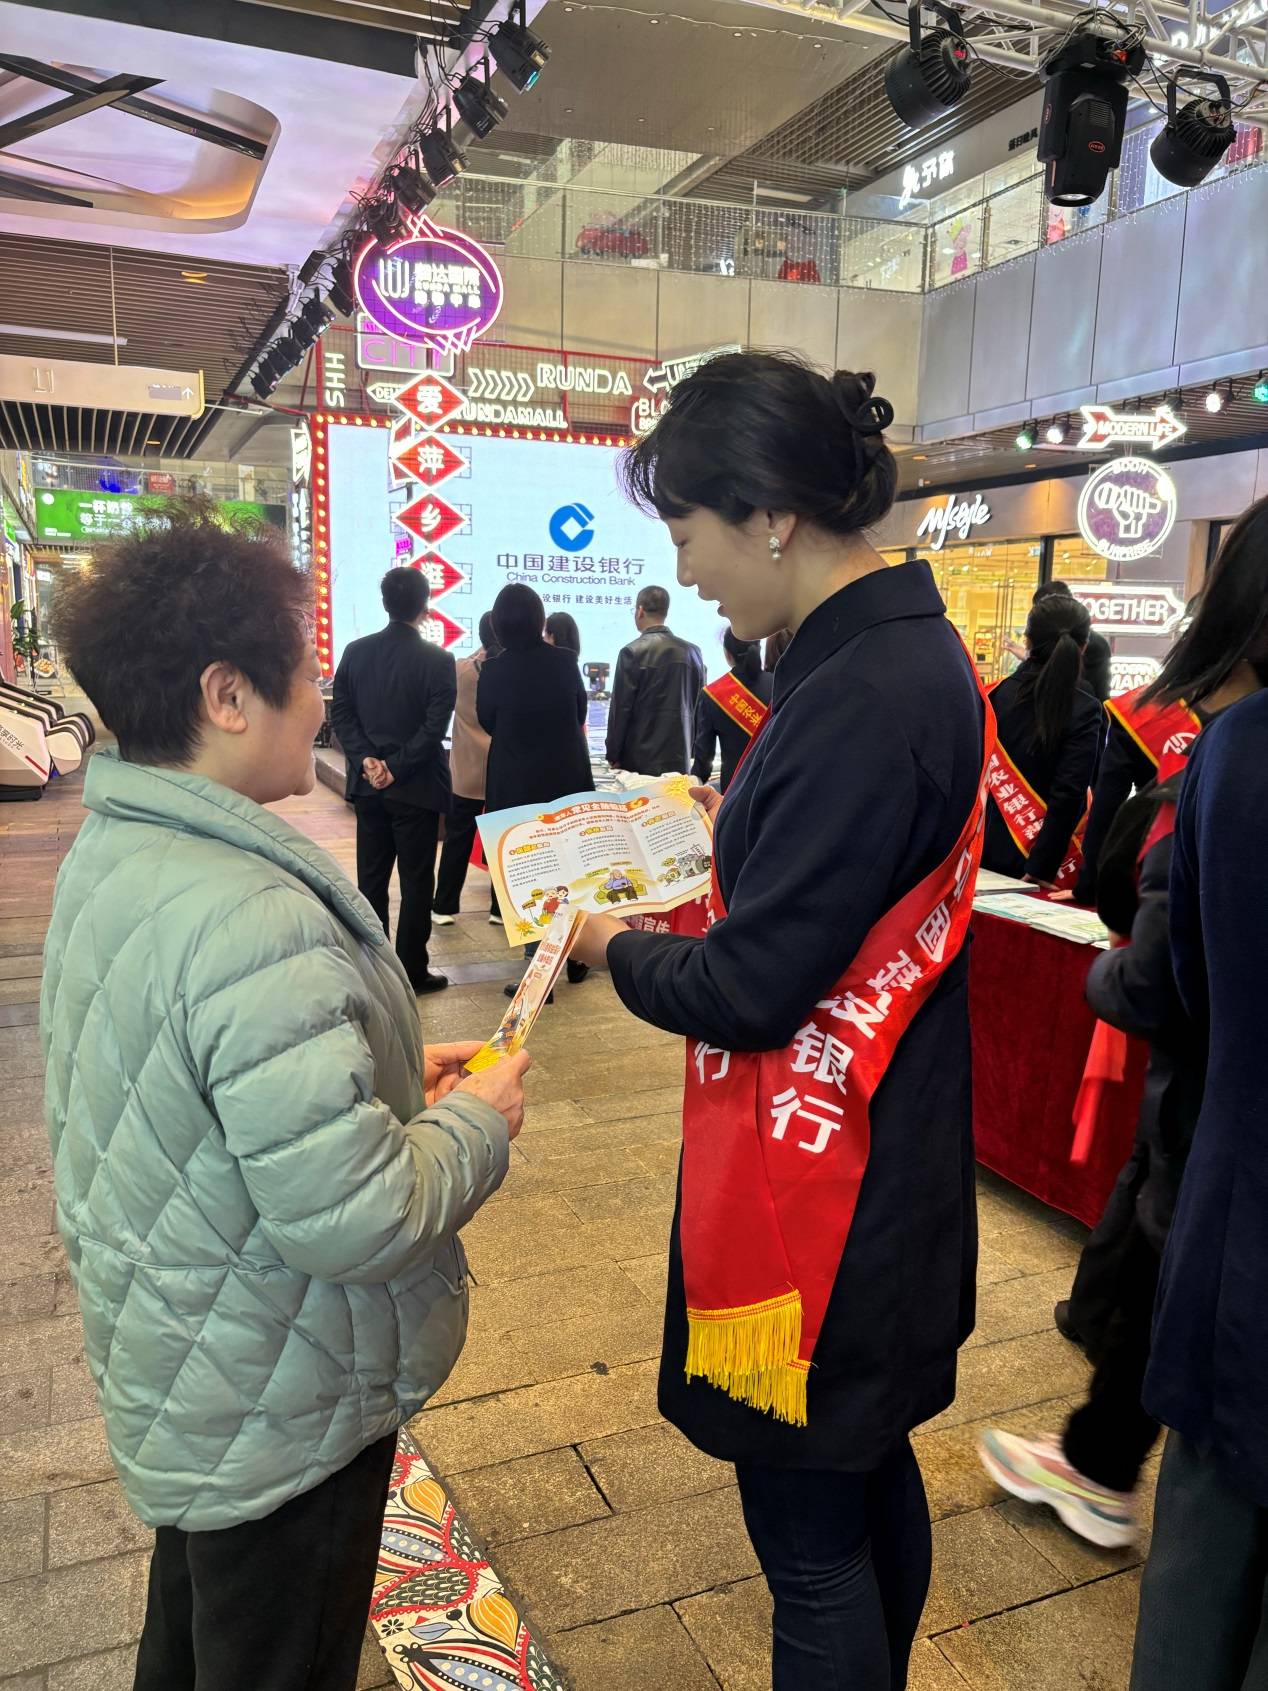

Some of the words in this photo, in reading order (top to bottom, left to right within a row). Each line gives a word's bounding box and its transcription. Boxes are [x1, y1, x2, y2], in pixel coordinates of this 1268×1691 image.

[537, 363, 632, 395] RUNDA
[1097, 420, 1148, 435] MODERN
[496, 552, 645, 575] 中国建设银行
[506, 571, 538, 583] China
[541, 572, 607, 585] Construction
[609, 574, 636, 586] Bank
[575, 594, 633, 605] 建设美好生活
